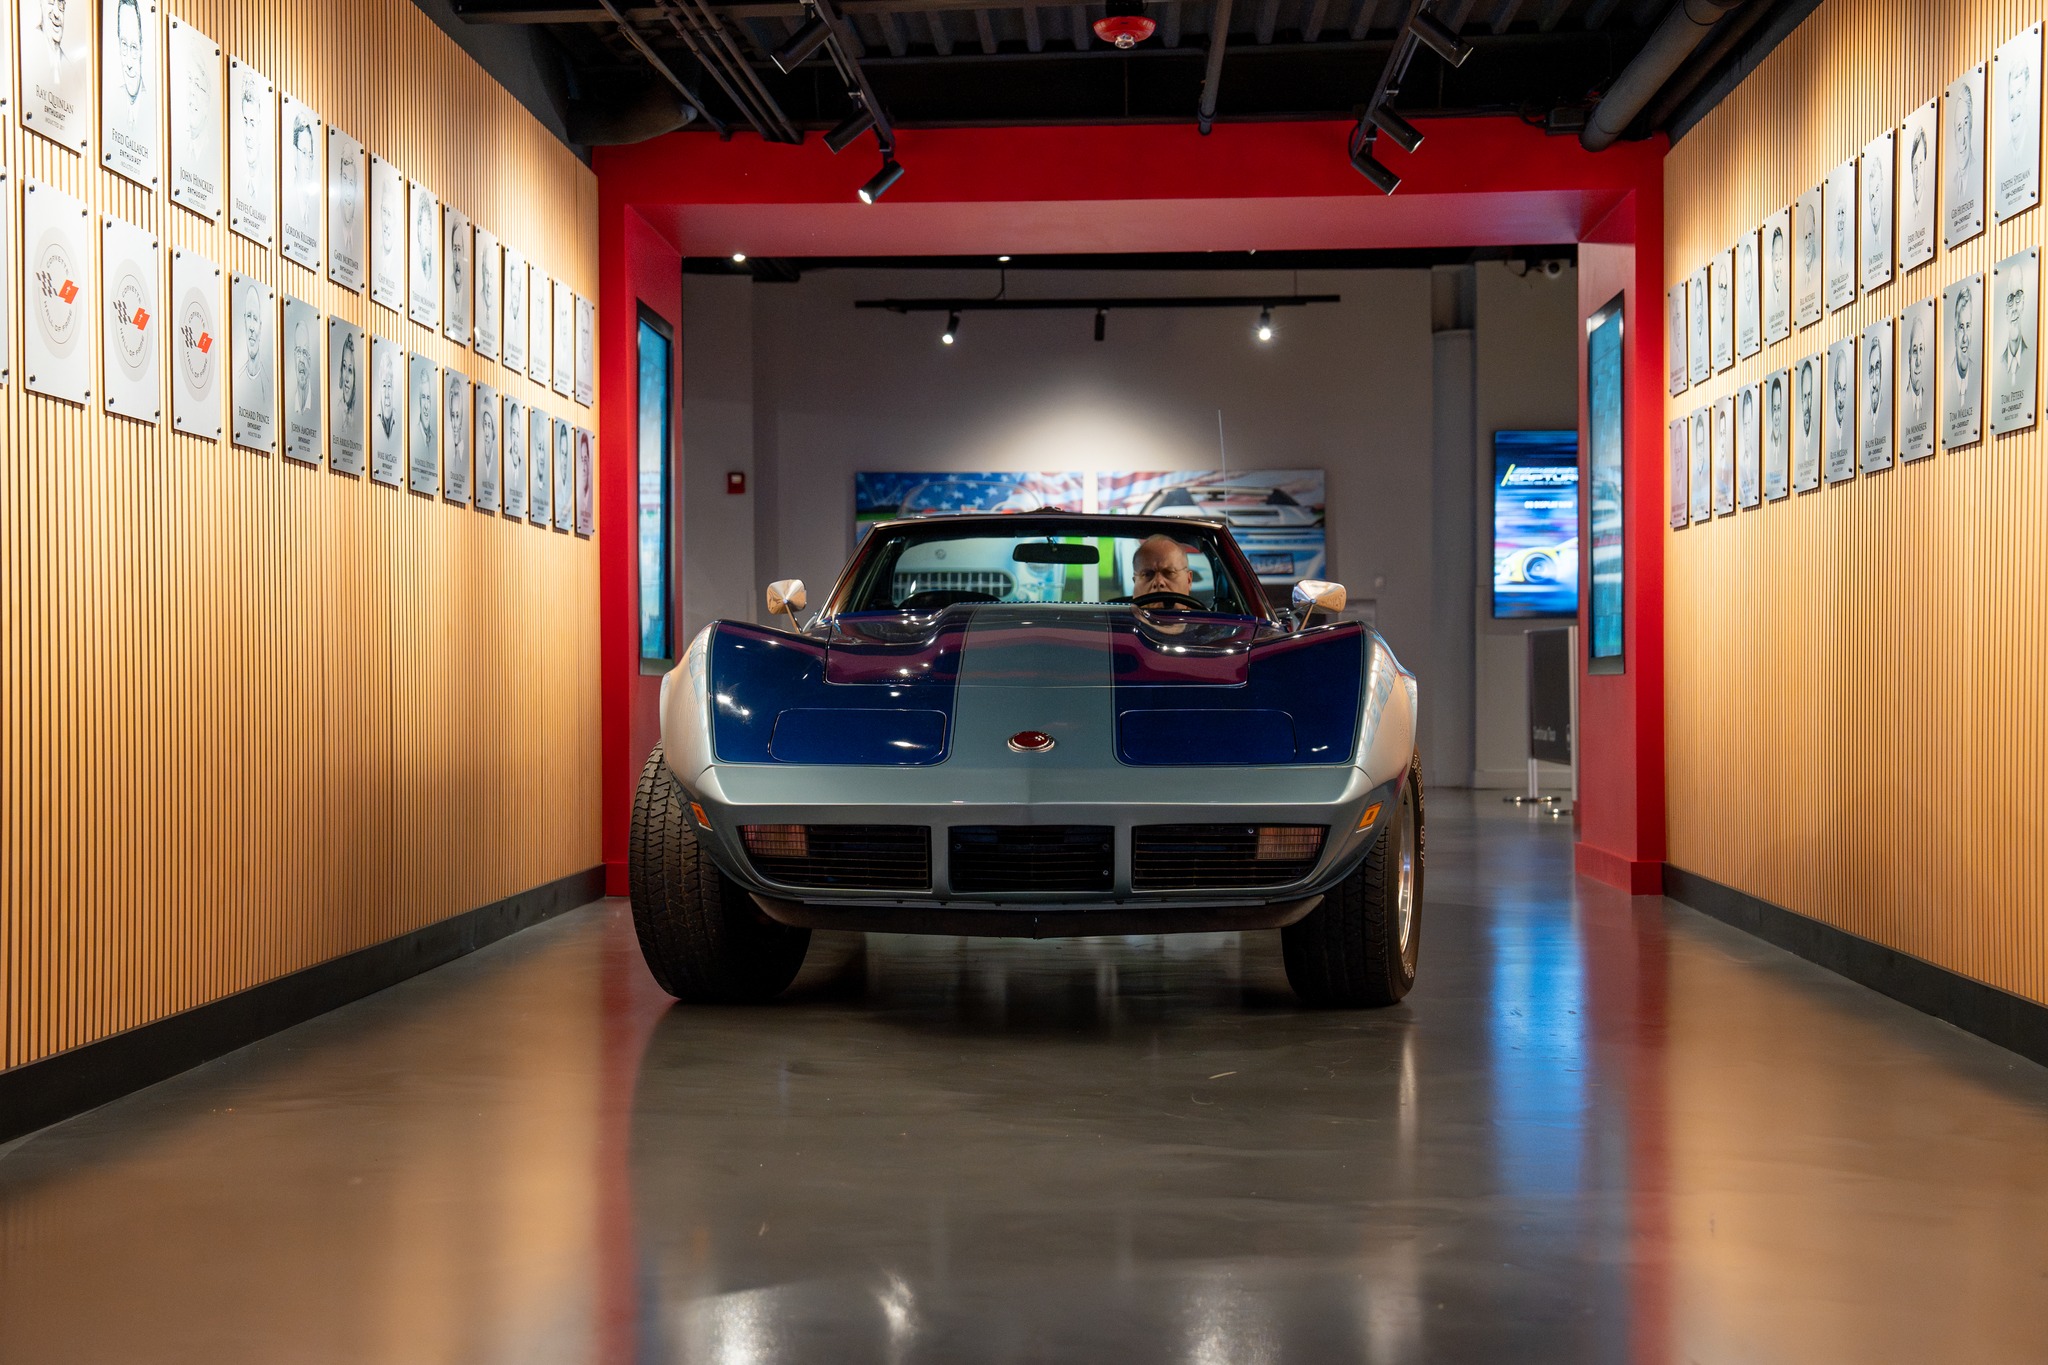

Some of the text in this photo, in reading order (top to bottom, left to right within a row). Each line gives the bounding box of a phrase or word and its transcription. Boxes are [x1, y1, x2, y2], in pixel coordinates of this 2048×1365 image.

[36, 84, 74, 114] RAY QUINLAN
[44, 105, 66, 121] ENTHUSIAST
[112, 128, 148, 159] FRED GALLASCH
[119, 149, 142, 166] ENTHUSIAST
[180, 166, 214, 194] JOHN HINCKLEY
[187, 186, 207, 201] ENTHUSIAST
[236, 198, 267, 224] REEVES CALLAWAY
[285, 223, 300, 239] GORDON
[334, 249, 342, 262] GARY
[2001, 390, 2024, 404] TOM PETERS
[239, 406, 270, 425] RICHARD PRINCE
[1949, 407, 1973, 422] TOM WALLACE
[291, 421, 300, 433] JOHN
